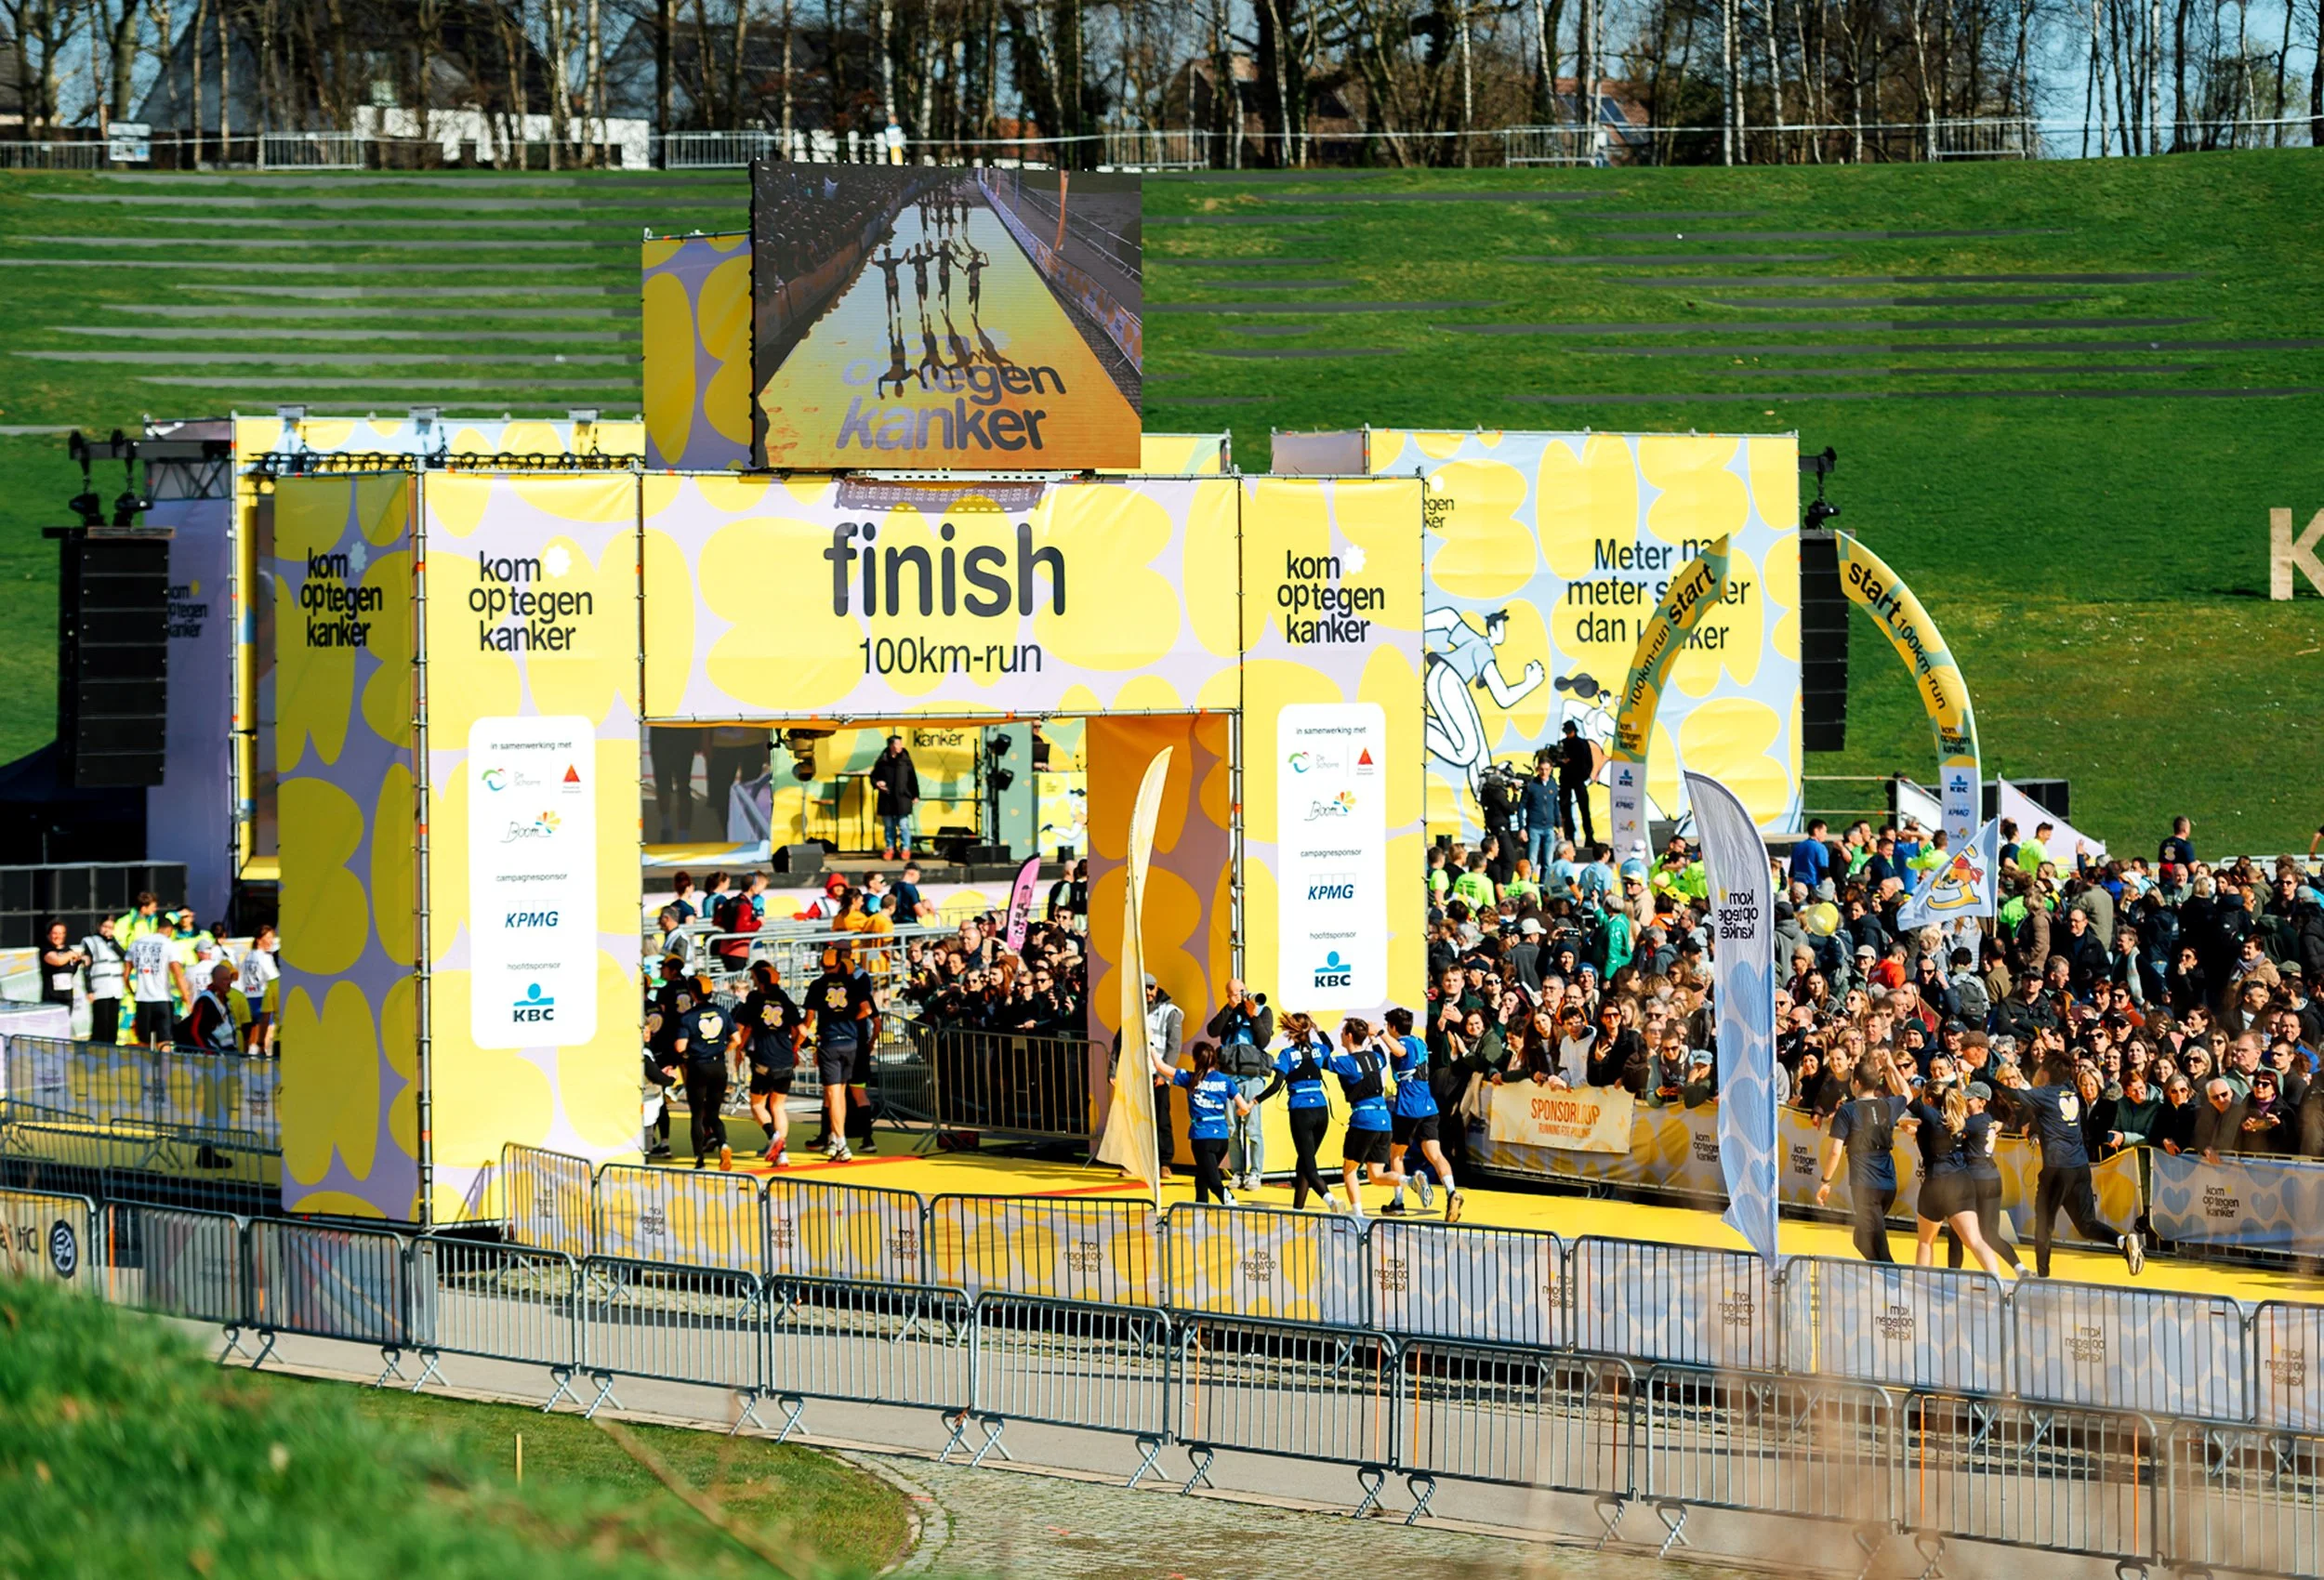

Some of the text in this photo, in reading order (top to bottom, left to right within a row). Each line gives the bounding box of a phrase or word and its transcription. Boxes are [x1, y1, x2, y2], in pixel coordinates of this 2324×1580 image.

[836, 395, 1047, 452] kanker
[308, 546, 349, 578] kom
[1594, 538, 1673, 571] Meter
[2269, 507, 2324, 600] K
[480, 550, 541, 582] kom
[823, 520, 1066, 617] finish
[1287, 549, 1340, 579] kom
[169, 585, 190, 599] om
[1567, 575, 1648, 605] meter
[1669, 562, 1718, 625] start
[168, 622, 203, 638] anker
[306, 614, 371, 648] kanker
[480, 619, 576, 652] kanker
[1287, 612, 1371, 643] kanker
[1576, 611, 1626, 643] dan
[1848, 561, 1947, 711] start 100km-run
[859, 636, 1042, 675] 100km-run
[1631, 623, 1671, 706] 100km-run
[913, 730, 965, 747] kanker
[1296, 726, 1367, 735] in samenwerking met
[490, 741, 573, 751] in samenwerking met
[1949, 785, 1968, 794] KBC
[1948, 808, 1971, 817] KPMG
[1300, 849, 1363, 860] campagnesponsor
[495, 873, 568, 883] campagnesponsor
[1307, 883, 1354, 901] KPMG
[505, 910, 560, 928] KPMG
[1309, 930, 1357, 940] hoofdsponsor
[1314, 974, 1352, 988] KBC
[512, 1007, 555, 1022] KBC
[1695, 1131, 1710, 1142] kom
[1793, 1143, 1808, 1154] kom
[2206, 1184, 2225, 1196] kom
[2205, 1206, 2235, 1218] kanker
